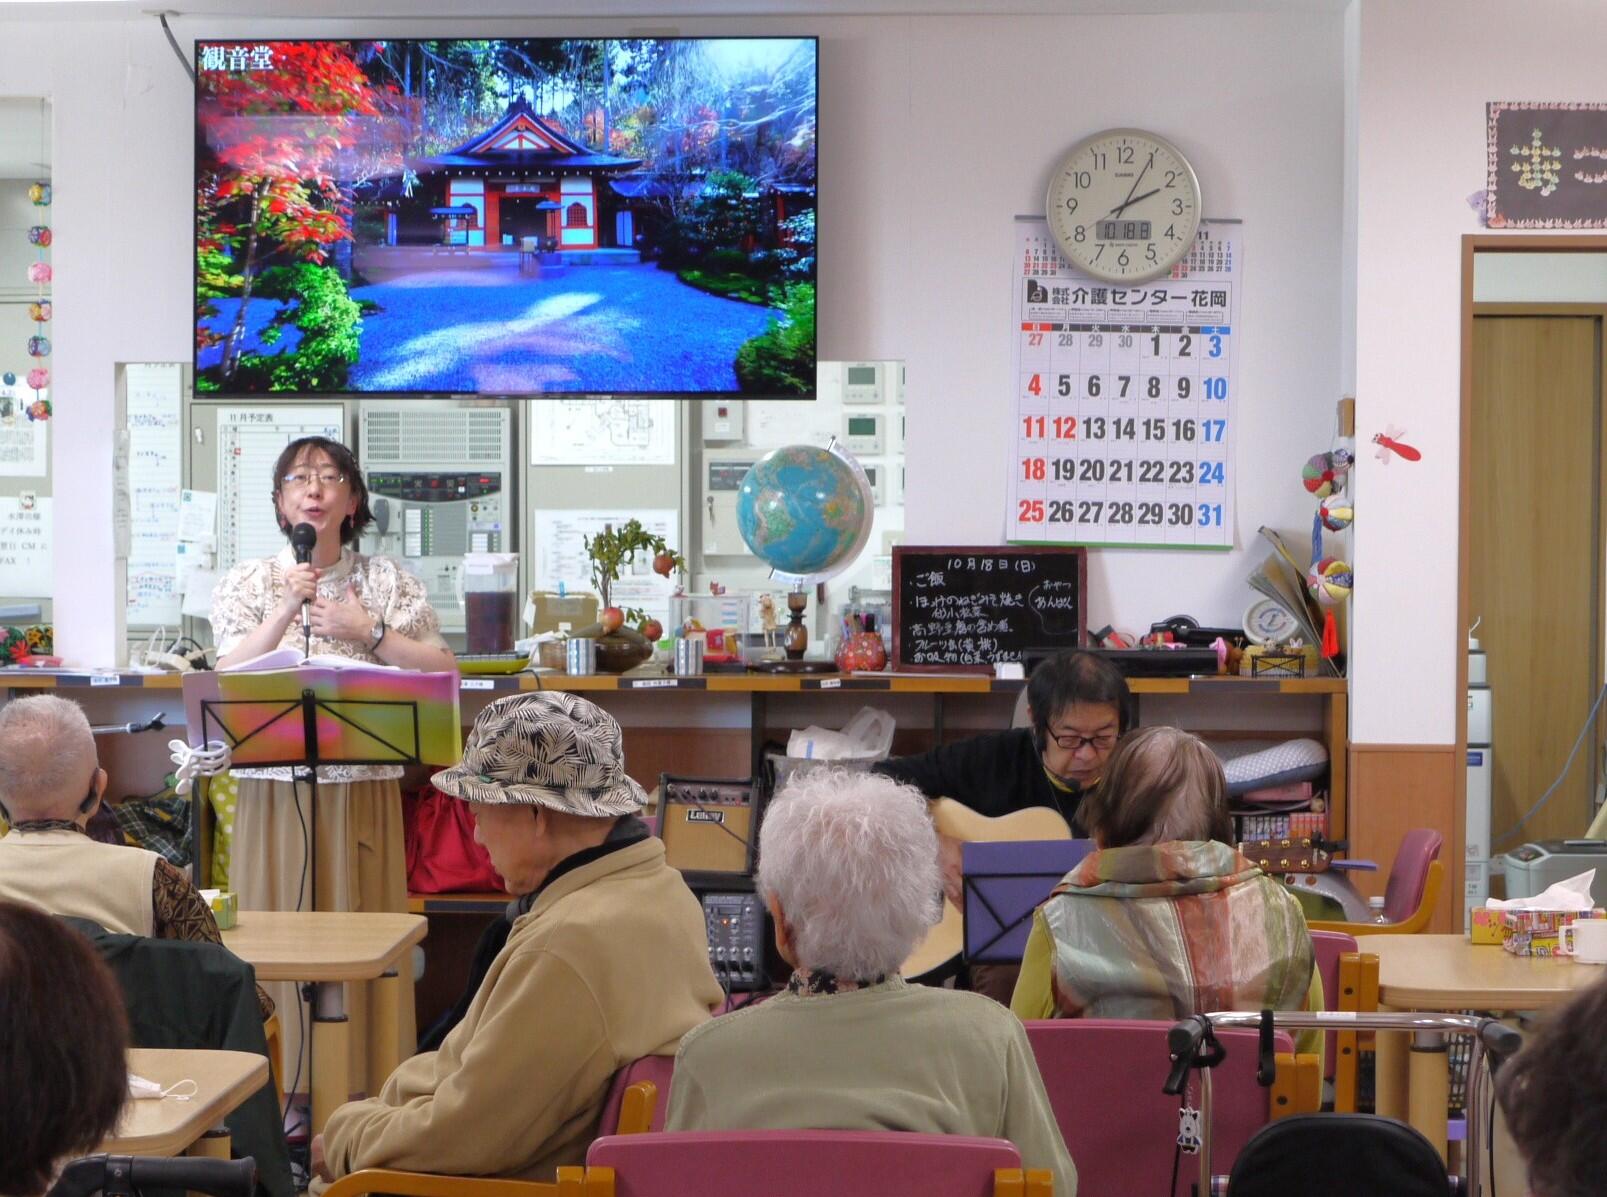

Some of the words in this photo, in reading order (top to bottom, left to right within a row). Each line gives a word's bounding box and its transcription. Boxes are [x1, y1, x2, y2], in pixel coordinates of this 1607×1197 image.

[202, 45, 274, 71] 観音堂
[1093, 153, 1106, 170] 11
[1117, 147, 1133, 164] 12
[1074, 172, 1090, 189] 10
[1165, 171, 1176, 188] 2
[1067, 198, 1078, 215] 9
[1172, 199, 1183, 216] 3
[1075, 225, 1085, 242] 8
[1105, 222, 1115, 240] 10
[1124, 222, 1135, 240] 18
[1164, 224, 1175, 240] 4
[1198, 231, 1208, 240] 11
[1095, 244, 1106, 260] 7
[1118, 250, 1129, 266] 6
[1145, 244, 1156, 260] 5
[1052, 287, 1070, 296] 株式
[1072, 287, 1226, 308] 介護センター花岡
[1052, 296, 1070, 305] 会社
[1029, 334, 1043, 346] 27
[1059, 335, 1072, 346] 28
[1089, 335, 1102, 347] 29
[1118, 335, 1132, 348] 30
[1151, 335, 1160, 356] 1
[1178, 335, 1192, 357] 2
[1209, 336, 1222, 358] 3
[1028, 374, 1041, 396] 4
[1058, 375, 1070, 396] 5
[1088, 375, 1100, 397] 6
[1118, 376, 1130, 397] 7
[1147, 377, 1160, 398] 8
[1178, 377, 1191, 398] 9
[1203, 377, 1226, 399] 10
[1023, 416, 1045, 439] 11
[1053, 417, 1076, 439] 12
[1082, 417, 1105, 439] 13
[1113, 418, 1135, 440] 14
[1142, 418, 1165, 440] 15
[1172, 419, 1195, 441] 16
[1202, 420, 1225, 441] 17
[1022, 458, 1045, 480] 18
[1052, 459, 1075, 480] 19
[1080, 460, 1104, 481] 20
[1109, 460, 1134, 482] 21
[1139, 461, 1164, 483] 22
[1169, 462, 1194, 483] 23
[1199, 462, 1224, 484] 24
[1019, 500, 1044, 522] 25
[1049, 501, 1074, 523] 26
[1079, 502, 1103, 523] 27
[1108, 502, 1133, 524] 28
[1138, 503, 1163, 524] 29
[1168, 503, 1193, 525] 30
[1198, 504, 1221, 526] 31
[916, 571, 946, 588] ご飯
